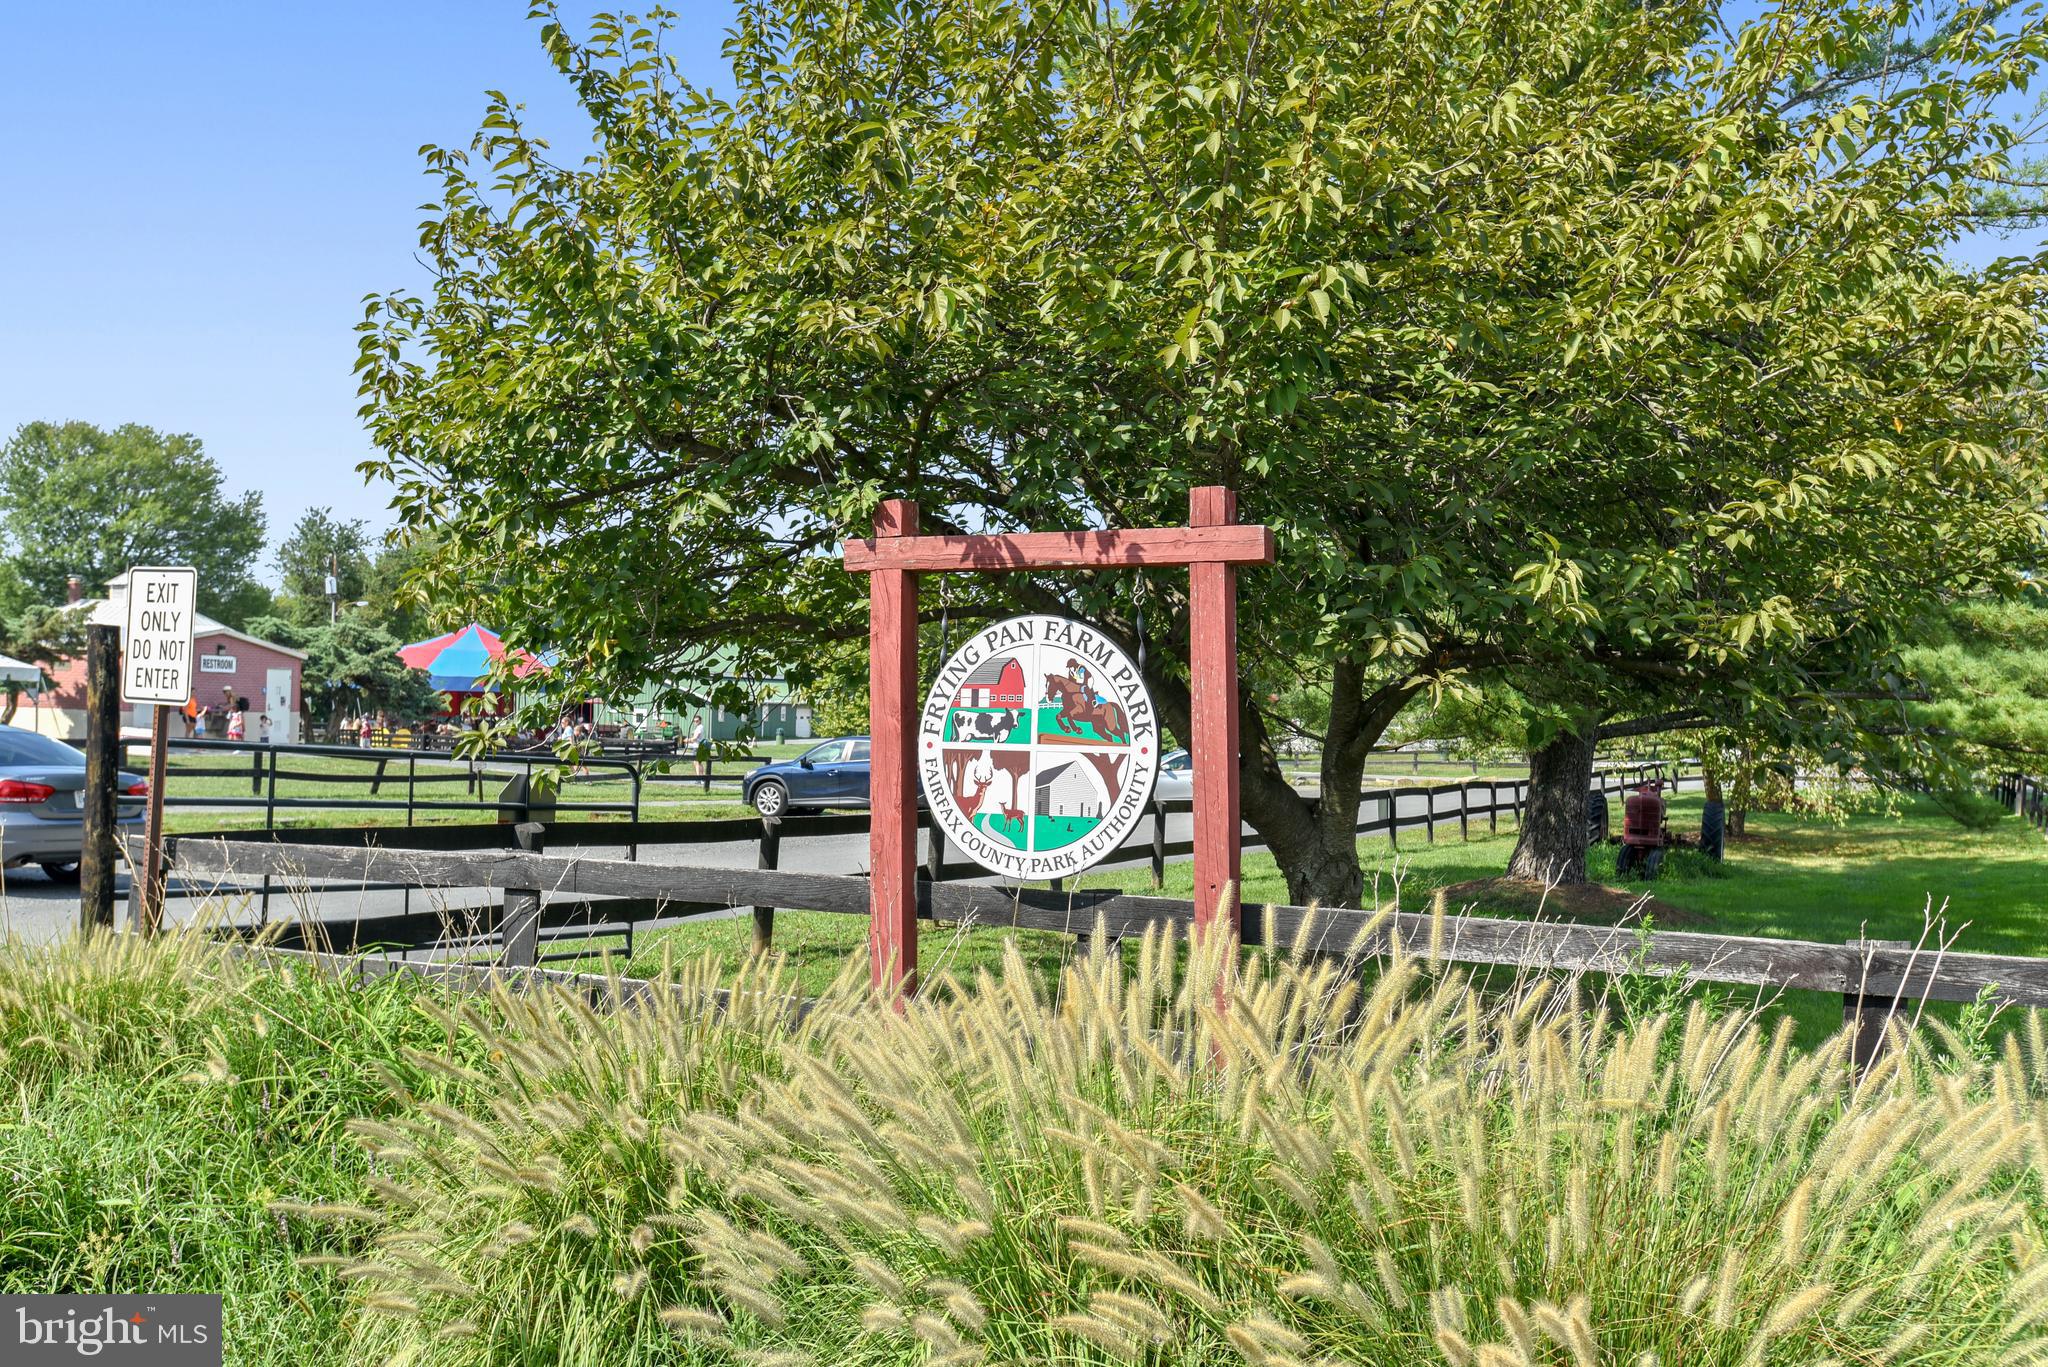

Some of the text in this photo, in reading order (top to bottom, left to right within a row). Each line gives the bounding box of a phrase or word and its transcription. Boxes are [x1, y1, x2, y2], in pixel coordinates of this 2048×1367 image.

[147, 583, 179, 604] EXIT
[141, 611, 181, 632] ONLY
[133, 639, 185, 661] DO NOT
[202, 658, 234, 670] RESTROOM
[135, 667, 179, 690] ENTER
[923, 621, 1153, 741] FRYING PAN FARM PARK
[925, 757, 1149, 873] FAIRFAX COUNTY PARK AUTHORITY
